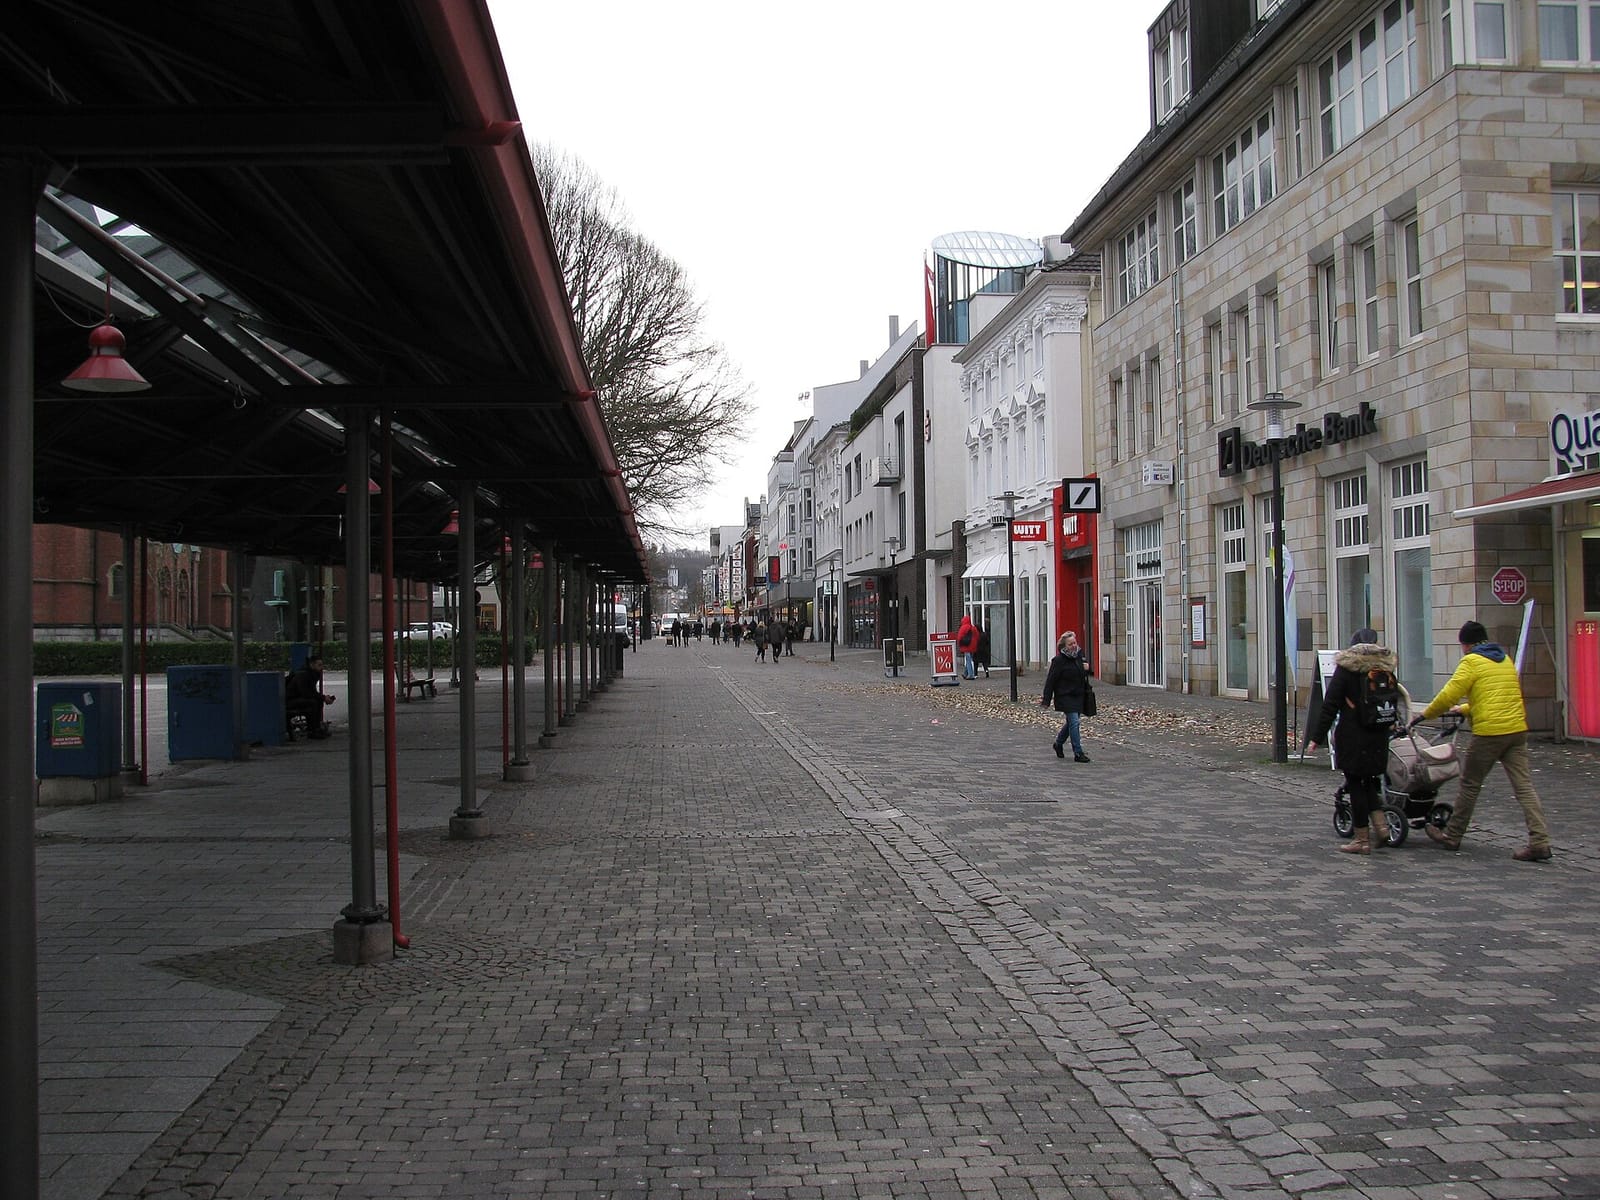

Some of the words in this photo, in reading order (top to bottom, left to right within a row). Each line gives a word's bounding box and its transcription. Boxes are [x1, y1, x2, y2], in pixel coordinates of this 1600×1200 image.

[1242, 423, 1322, 470] Deusche
[1324, 402, 1378, 446] Bank
[1013, 524, 1041, 535] WITT
[1494, 579, 1524, 592] STOP
